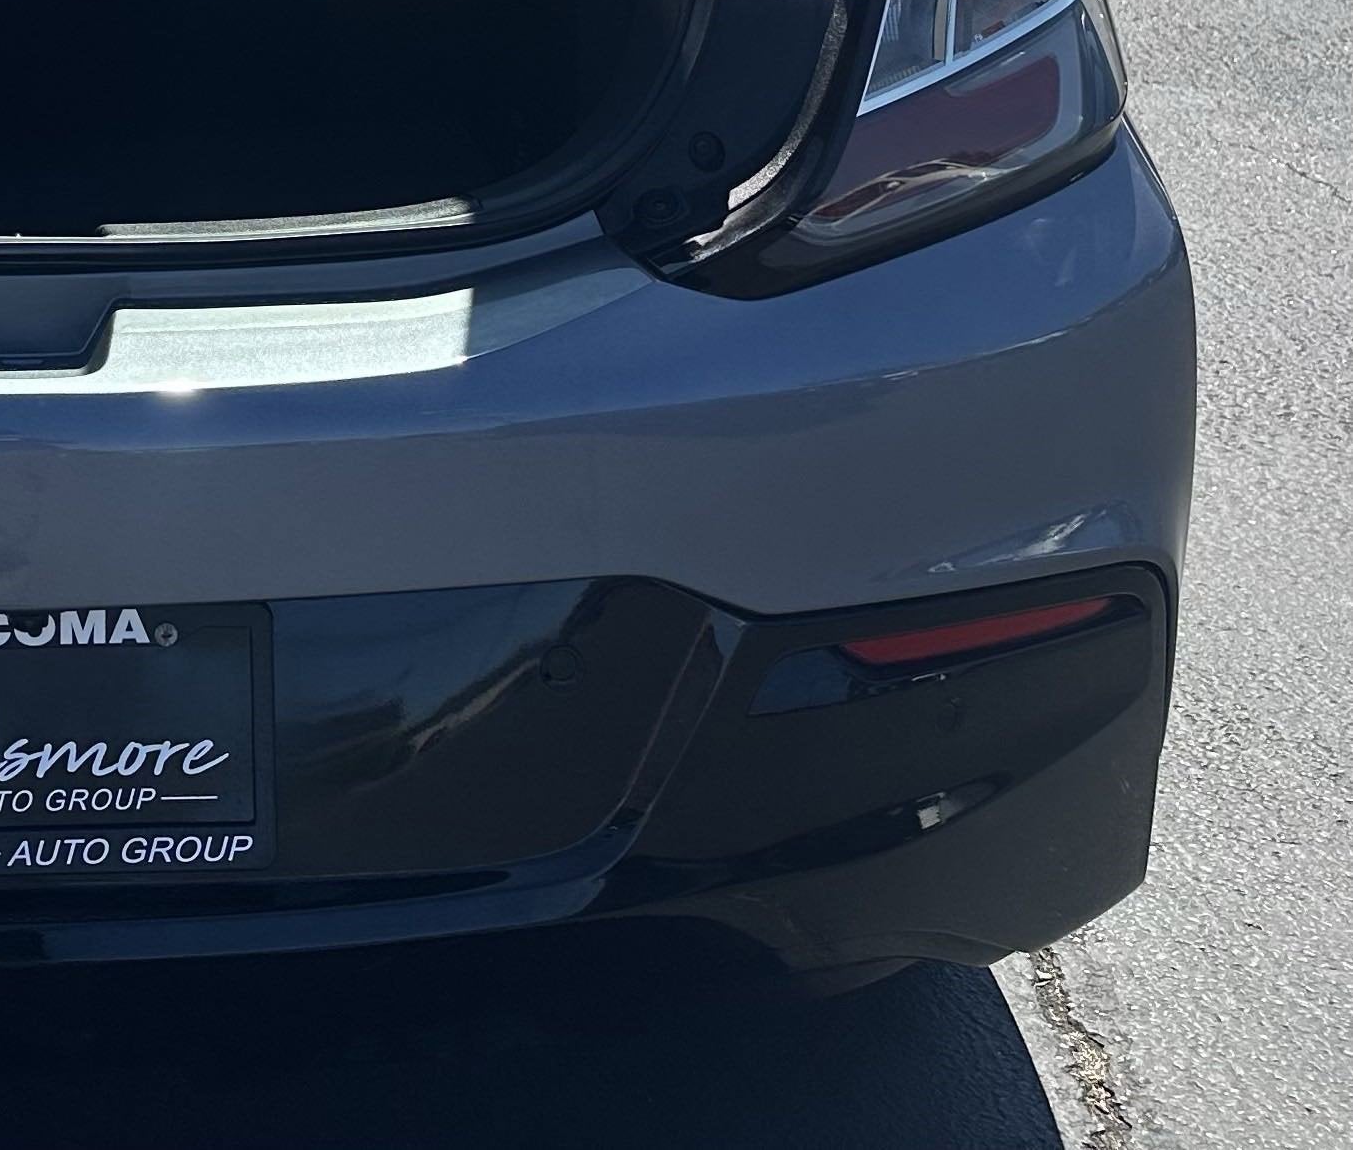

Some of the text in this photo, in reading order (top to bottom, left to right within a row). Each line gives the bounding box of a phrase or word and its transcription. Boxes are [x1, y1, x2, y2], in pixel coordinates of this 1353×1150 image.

[45, 788, 156, 812] GROUP
[7, 838, 109, 867] AUTO
[121, 835, 254, 864] GROUP
